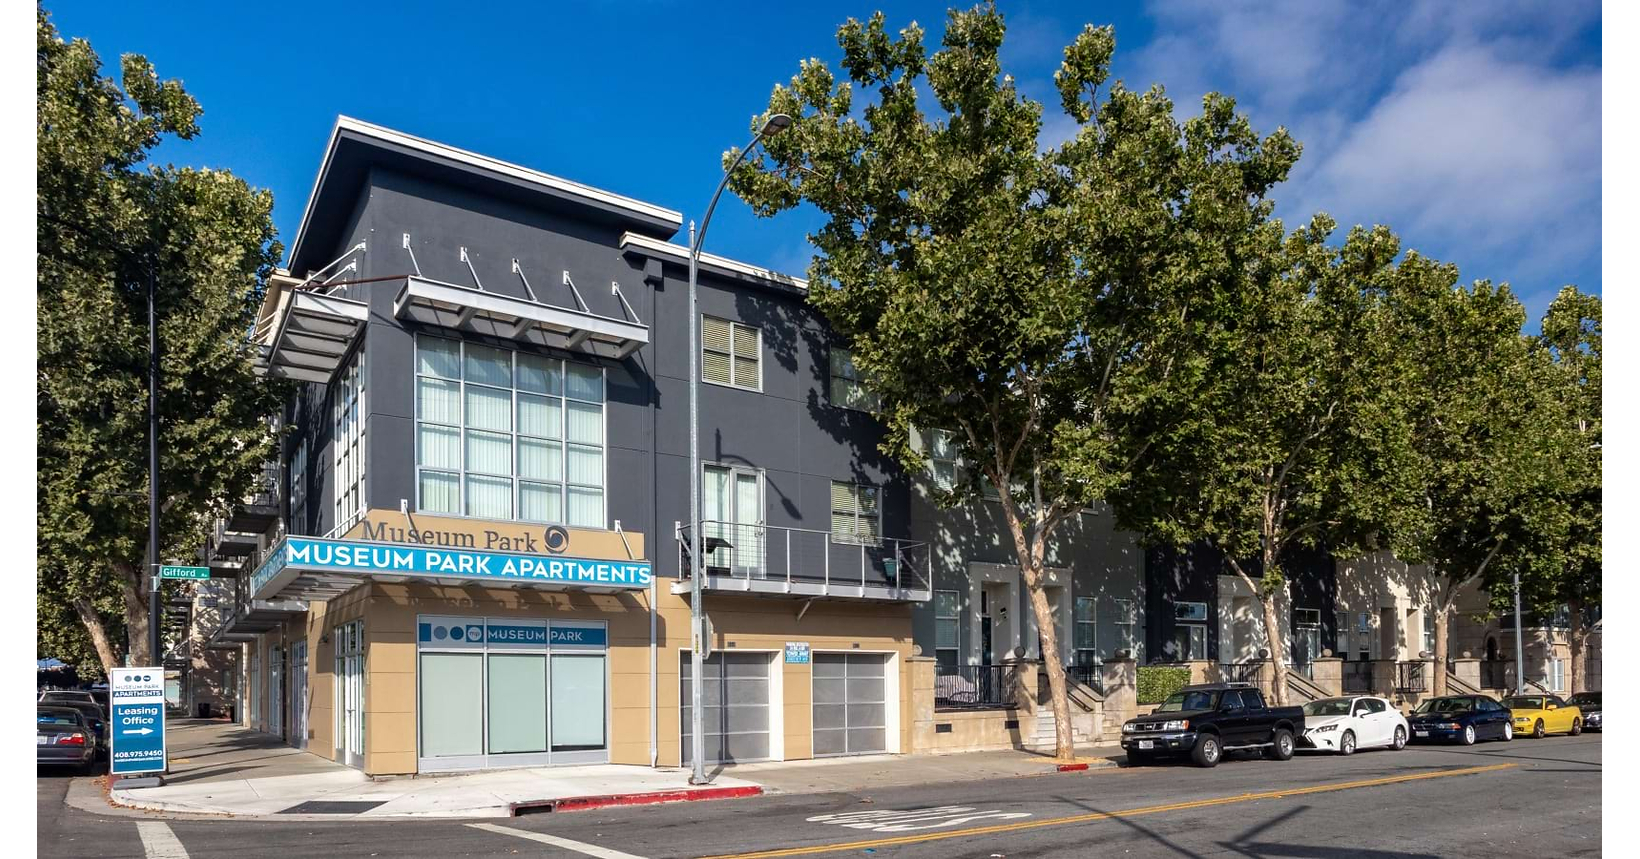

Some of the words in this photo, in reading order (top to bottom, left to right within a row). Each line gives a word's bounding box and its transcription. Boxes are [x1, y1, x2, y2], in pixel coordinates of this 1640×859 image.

[361, 519, 475, 549] Museum
[484, 530, 538, 553] Park
[288, 543, 414, 569] MUSEUM
[426, 552, 492, 575] PARK
[501, 558, 651, 584] APARTMENTS
[163, 568, 196, 577] Gifford
[488, 629, 545, 640] MUSEUM
[551, 631, 583, 641] PARK
[114, 690, 161, 698] APARTMENTS
[118, 706, 158, 716] Leasing
[122, 716, 154, 725] Office
[114, 750, 163, 758] 408.975.9450
